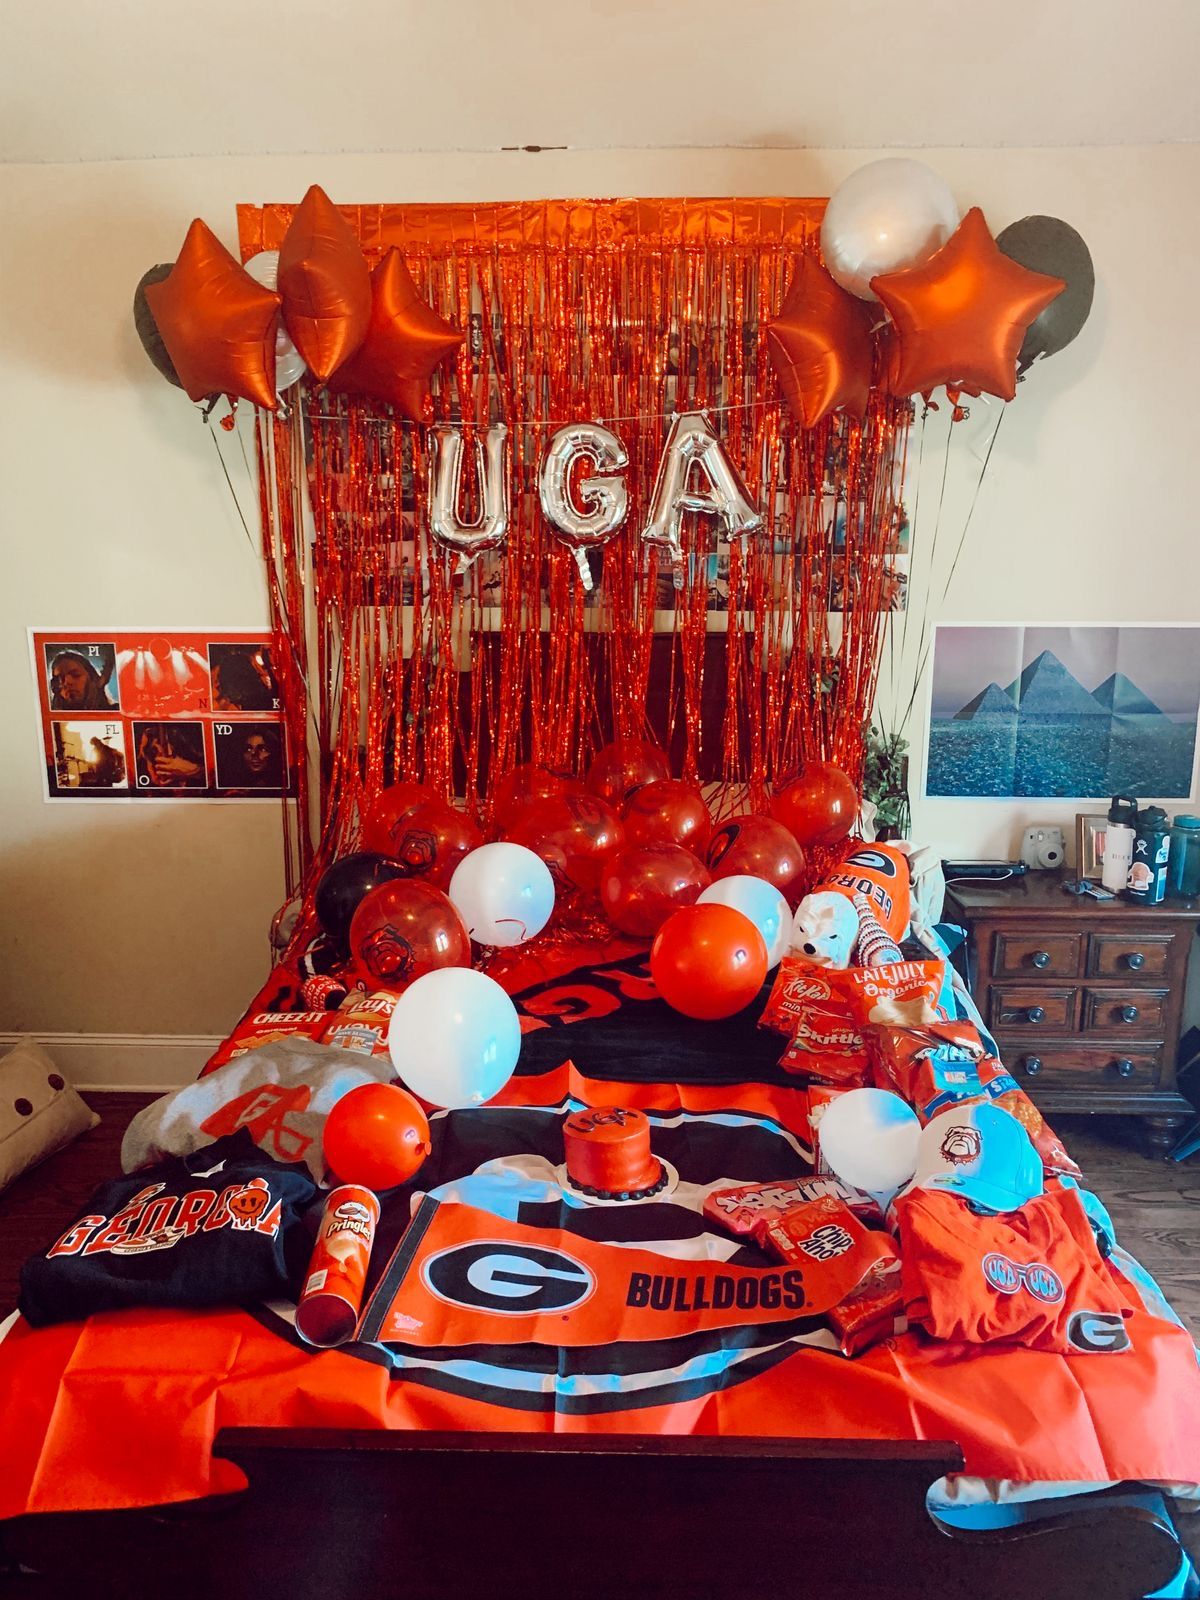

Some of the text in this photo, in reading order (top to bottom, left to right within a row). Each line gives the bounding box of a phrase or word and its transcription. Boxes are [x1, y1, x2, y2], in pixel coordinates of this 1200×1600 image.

[428, 409, 765, 551] UGA
[88, 646, 100, 657] PI
[105, 724, 120, 735] FL
[215, 724, 233, 735] YD
[853, 963, 926, 985] LATE JULY
[864, 980, 927, 1000] Organic
[348, 999, 395, 1015] Lay's
[797, 1023, 864, 1045] Skittle
[567, 1107, 638, 1133] UGA
[812, 1225, 855, 1251] Chip
